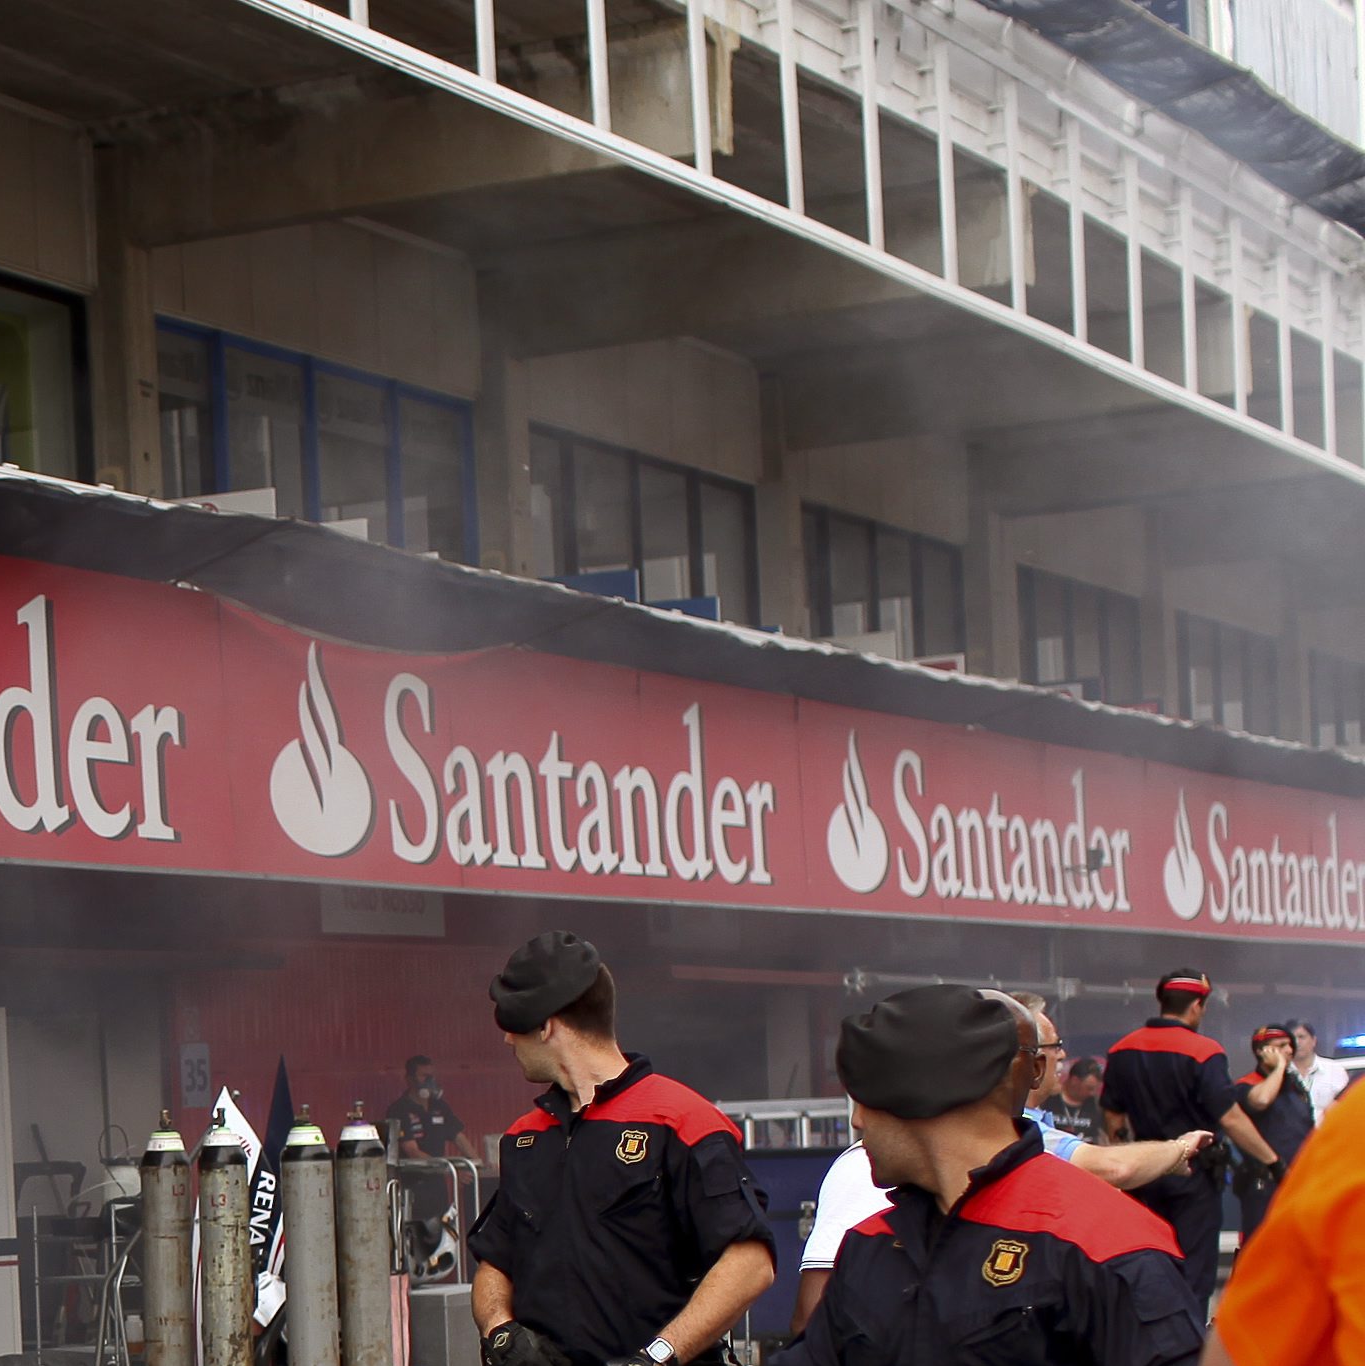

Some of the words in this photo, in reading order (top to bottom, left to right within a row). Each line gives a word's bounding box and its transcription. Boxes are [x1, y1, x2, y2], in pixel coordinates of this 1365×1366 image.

[383, 672, 776, 886] Santander
[892, 748, 1131, 912] Santander
[1207, 801, 1365, 932] Santander
[184, 1057, 208, 1093] 35
[210, 1193, 227, 1208] L3
[249, 1169, 277, 1248] RENA
